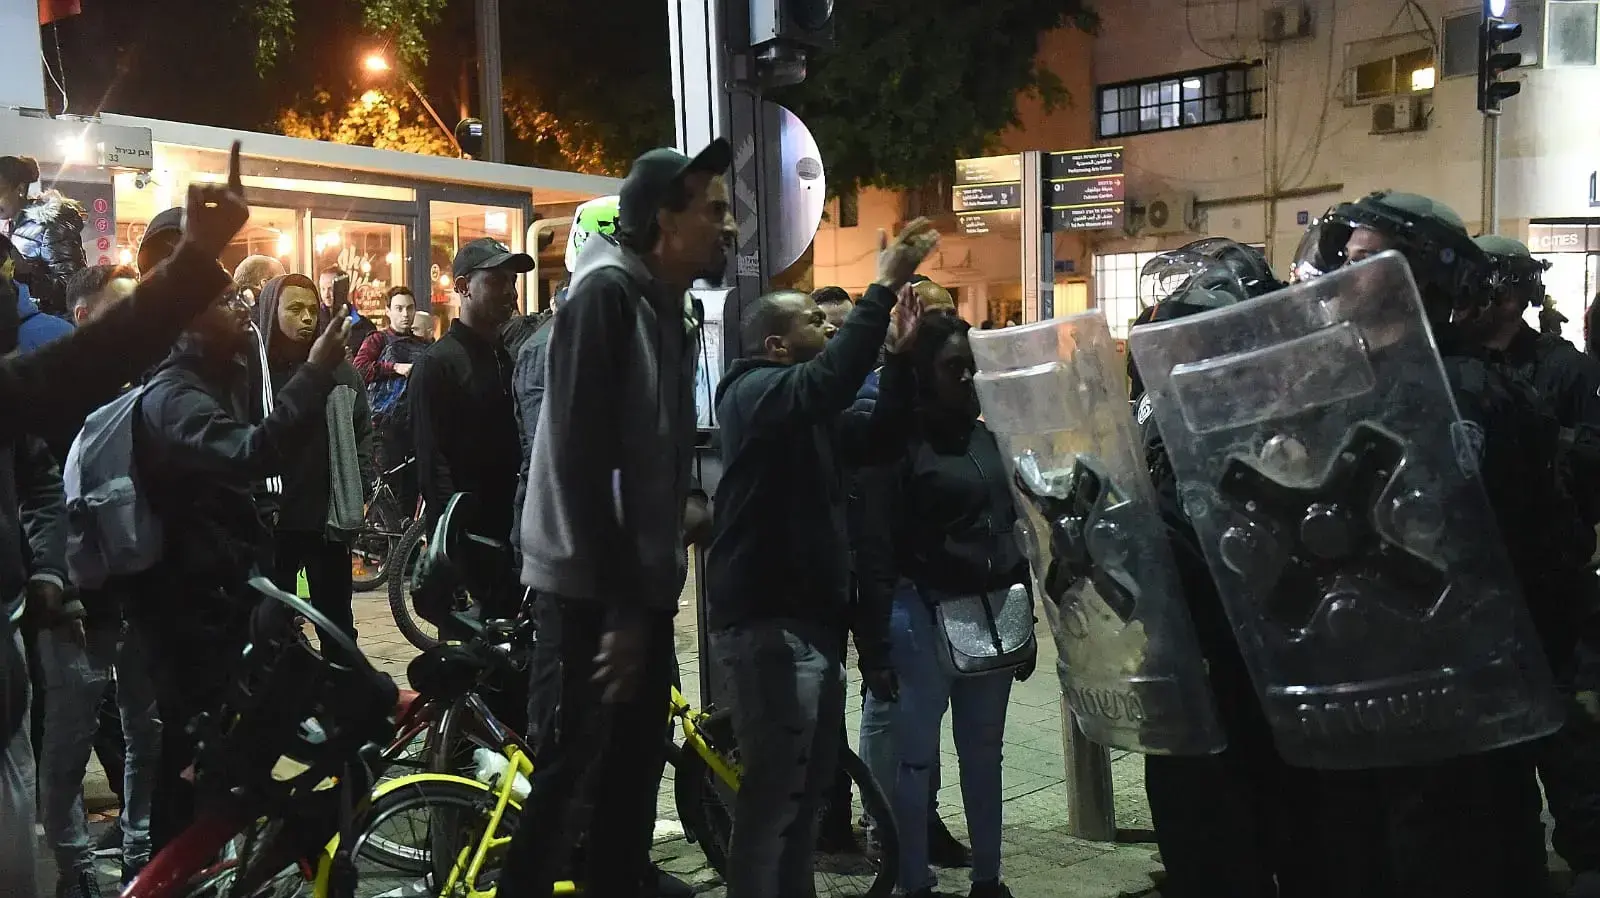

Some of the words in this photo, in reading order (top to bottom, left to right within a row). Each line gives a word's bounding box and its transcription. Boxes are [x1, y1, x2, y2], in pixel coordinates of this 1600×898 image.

[115, 146, 136, 154] גבירול
[138, 149, 150, 157] אבן
[108, 153, 119, 162] 33
